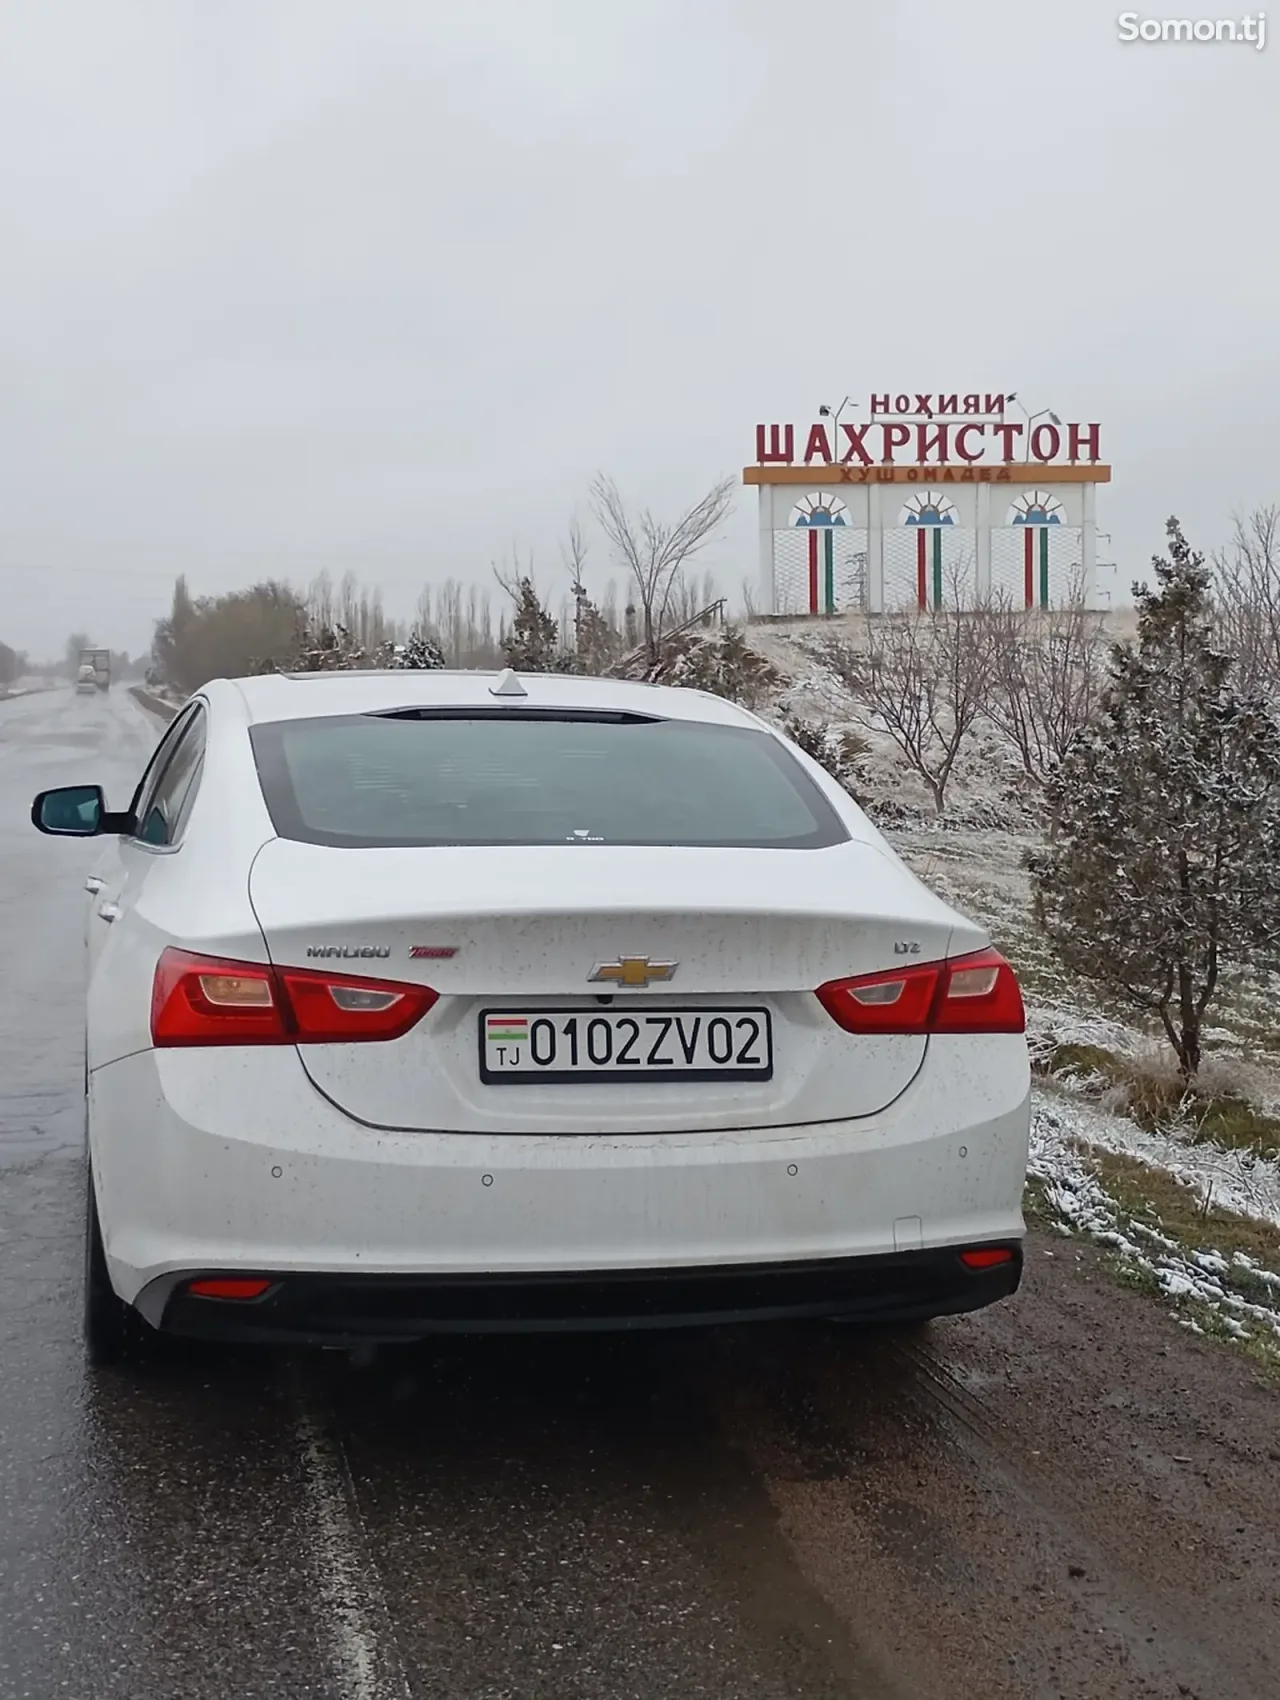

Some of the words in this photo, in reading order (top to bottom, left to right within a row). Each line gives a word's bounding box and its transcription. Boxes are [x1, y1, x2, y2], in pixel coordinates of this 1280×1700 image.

[841, 468, 895, 481] ХУШ
[907, 468, 1012, 482] ОМАДЕД
[495, 1047, 521, 1066] TJ
[530, 1017, 761, 1066] 0102ZV02
